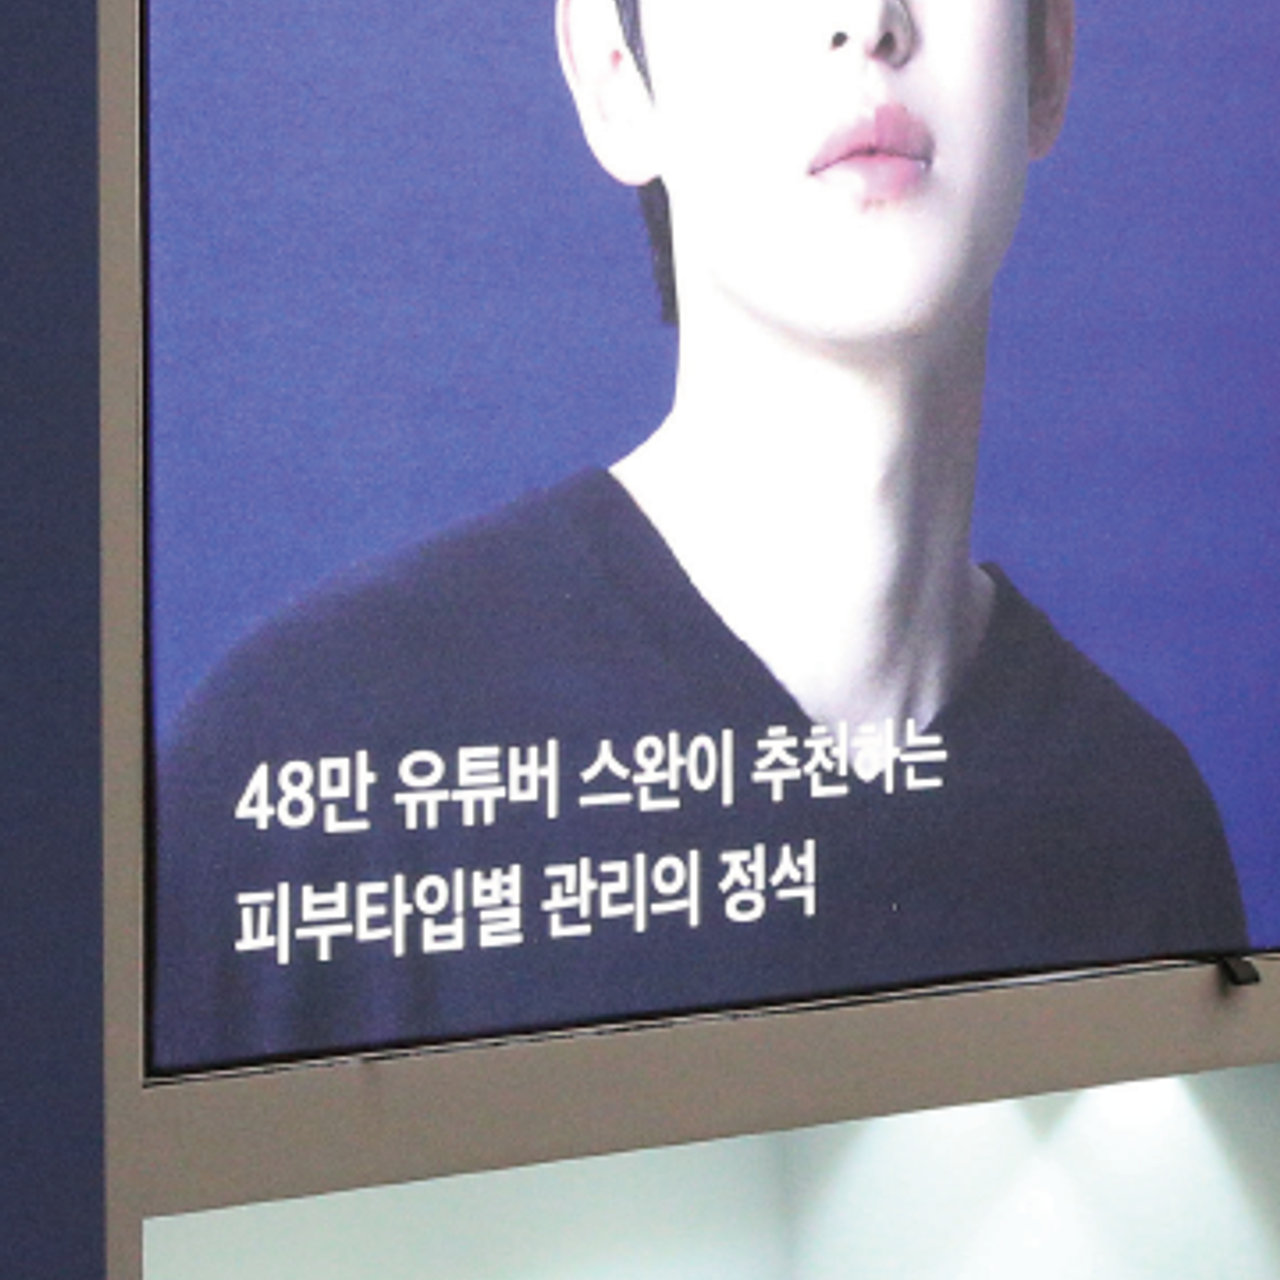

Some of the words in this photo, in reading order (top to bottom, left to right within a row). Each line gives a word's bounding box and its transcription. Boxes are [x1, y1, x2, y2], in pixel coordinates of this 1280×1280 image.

[235, 750, 376, 833] 48만
[394, 739, 559, 829] 유튜버
[579, 728, 734, 811] 스완이
[751, 717, 949, 804] 추천하는
[235, 864, 523, 964] 피부타입별
[541, 850, 700, 938] 관리의
[718, 838, 816, 923] 정석
